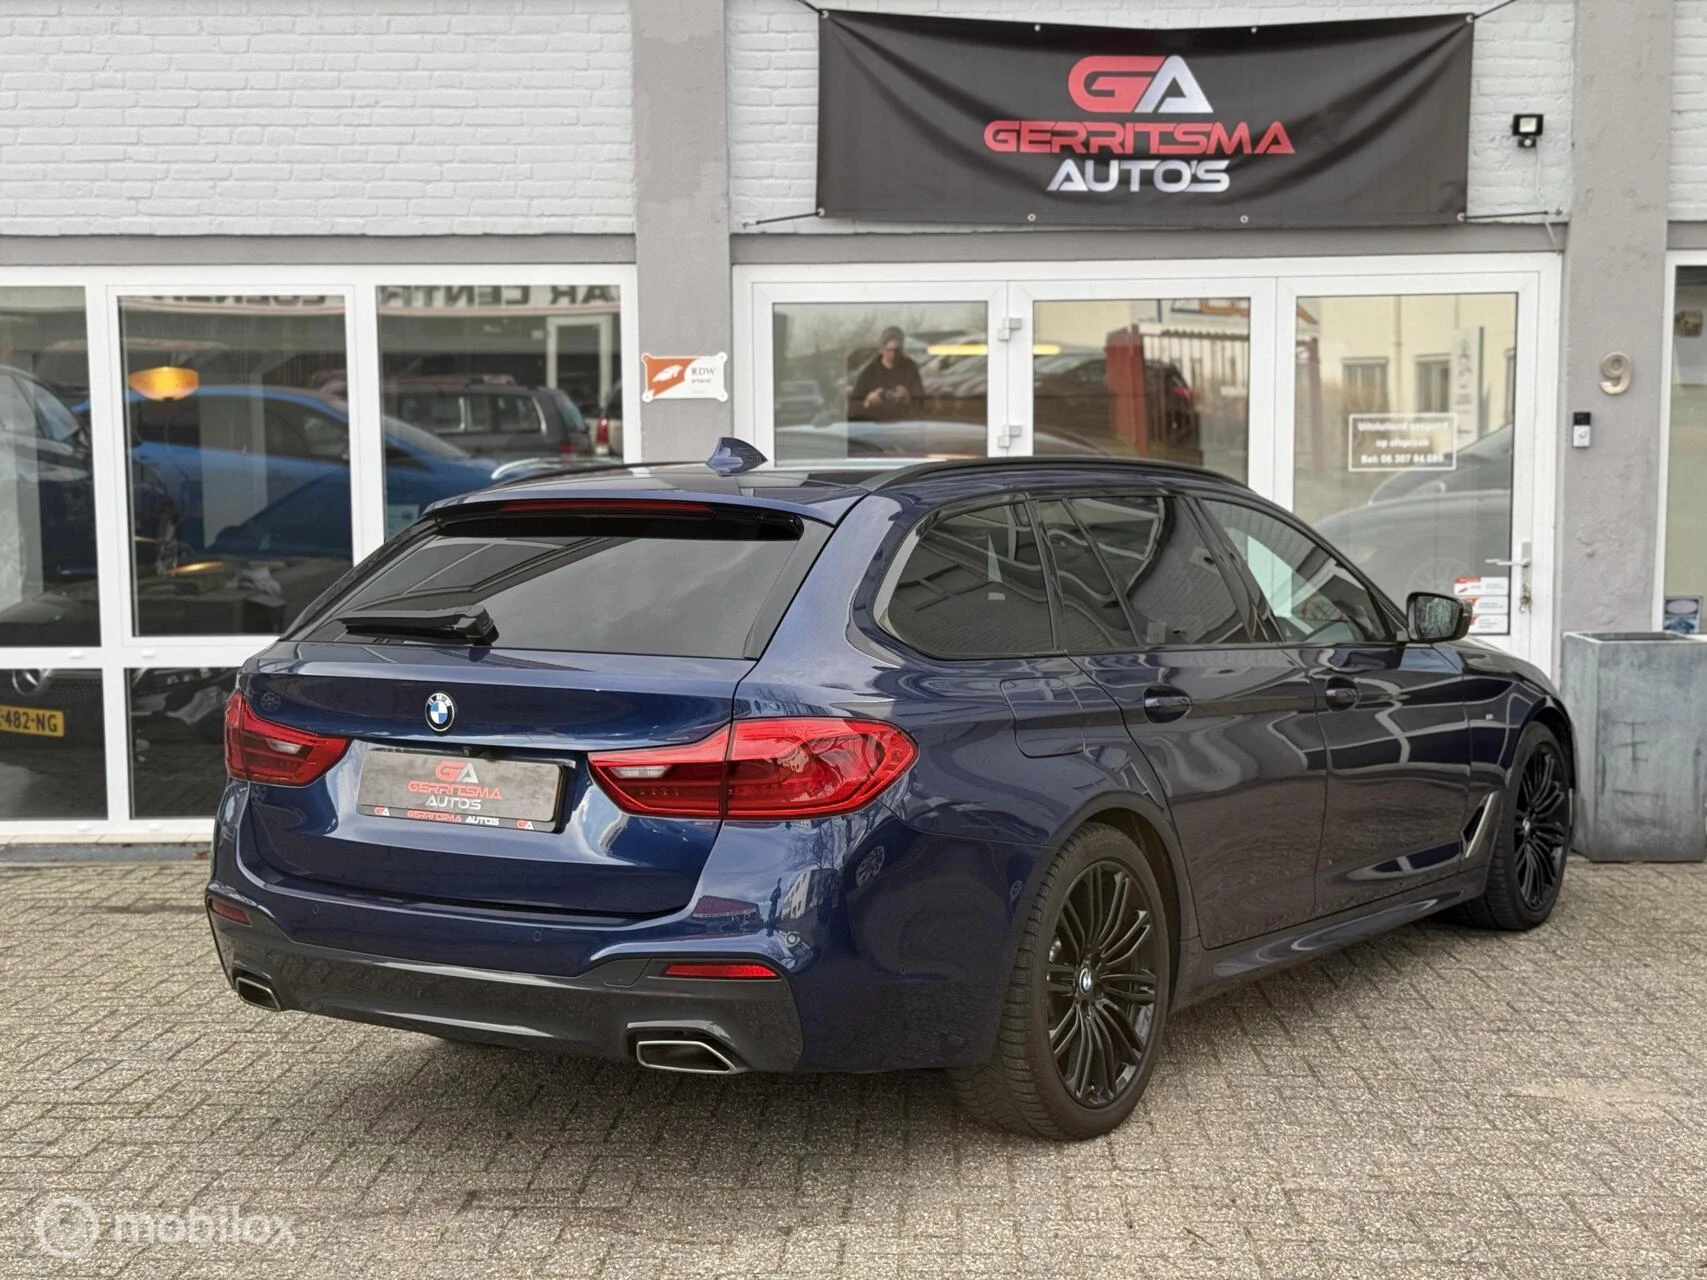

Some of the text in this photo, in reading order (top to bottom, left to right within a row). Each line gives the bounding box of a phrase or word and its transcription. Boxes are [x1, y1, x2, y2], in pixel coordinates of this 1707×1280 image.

[1067, 54, 1214, 114] GA
[983, 120, 1296, 155] GERRITSMA
[690, 367, 717, 376] RDW
[1599, 351, 1632, 396] 9
[0, 709, 57, 733] -482-NG
[435, 760, 479, 784] GA
[408, 780, 502, 800] GERRITSMA
